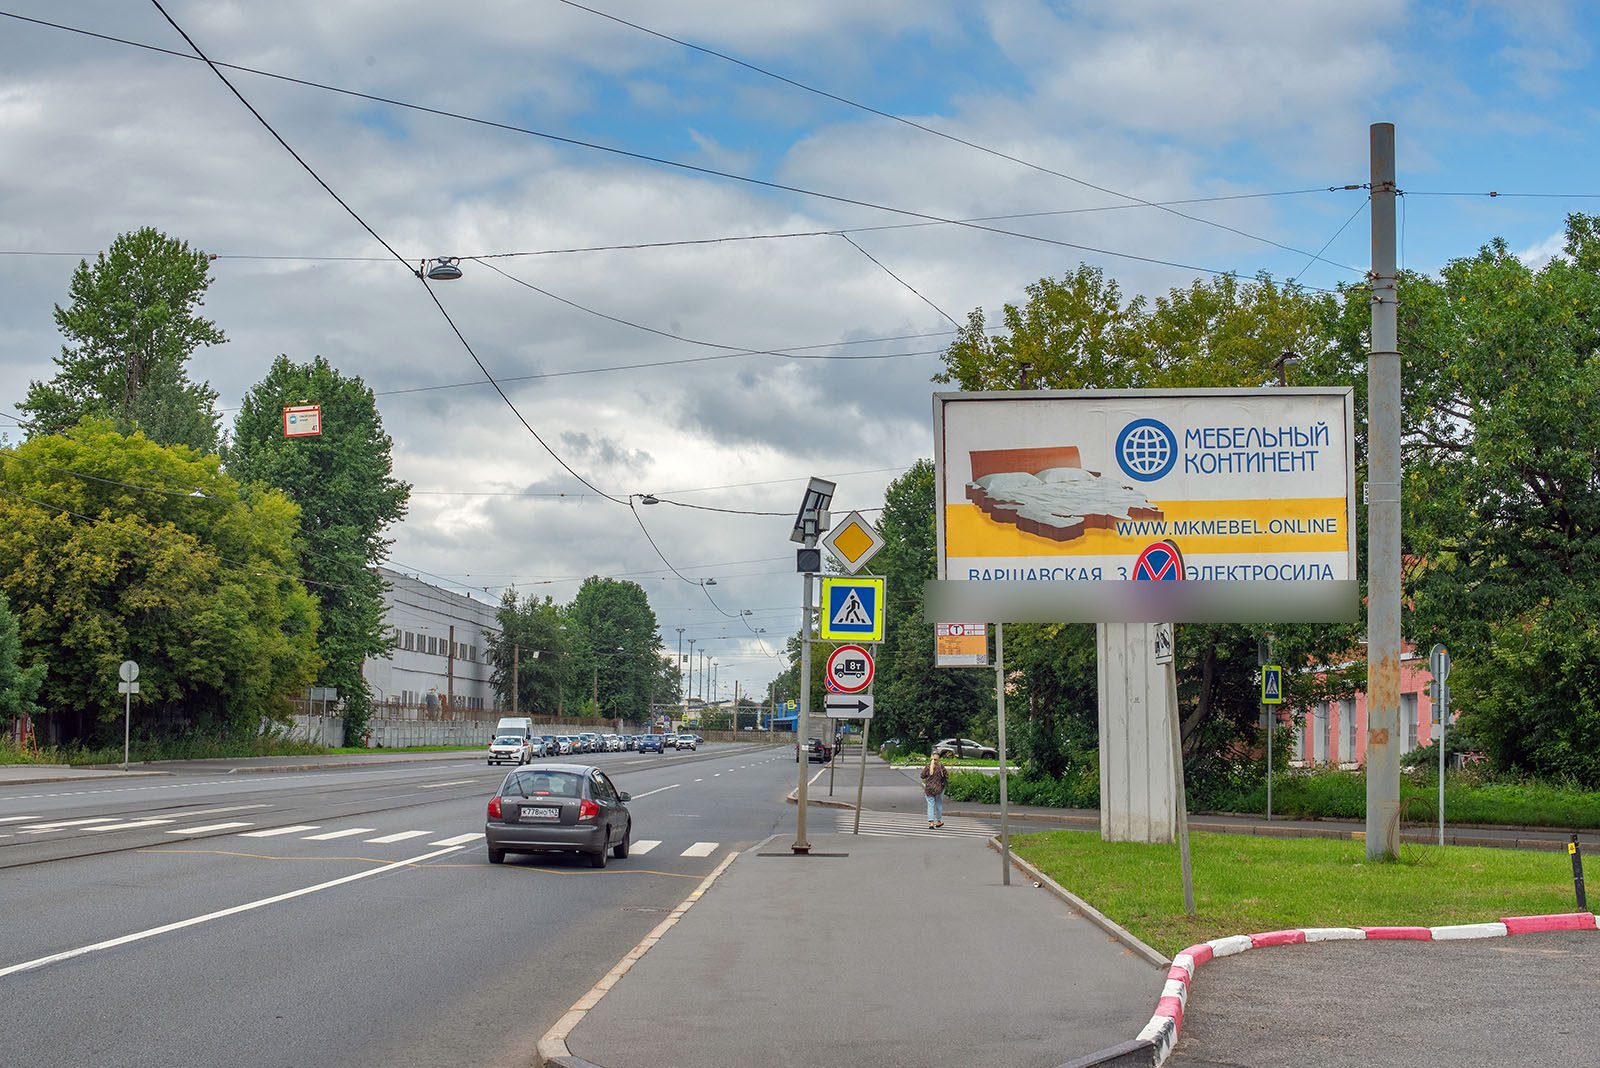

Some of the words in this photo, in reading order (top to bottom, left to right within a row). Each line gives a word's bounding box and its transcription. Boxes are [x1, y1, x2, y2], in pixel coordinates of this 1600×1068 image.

[1184, 421, 1329, 449] МЕБЕЛЬНЫЙ
[1185, 451, 1319, 474] КОНТИНЕНТ
[1116, 518, 1337, 536] WWW.MKMEBEL.ONLINE
[1186, 564, 1335, 580] ЭЛЕКТРОСИЛА
